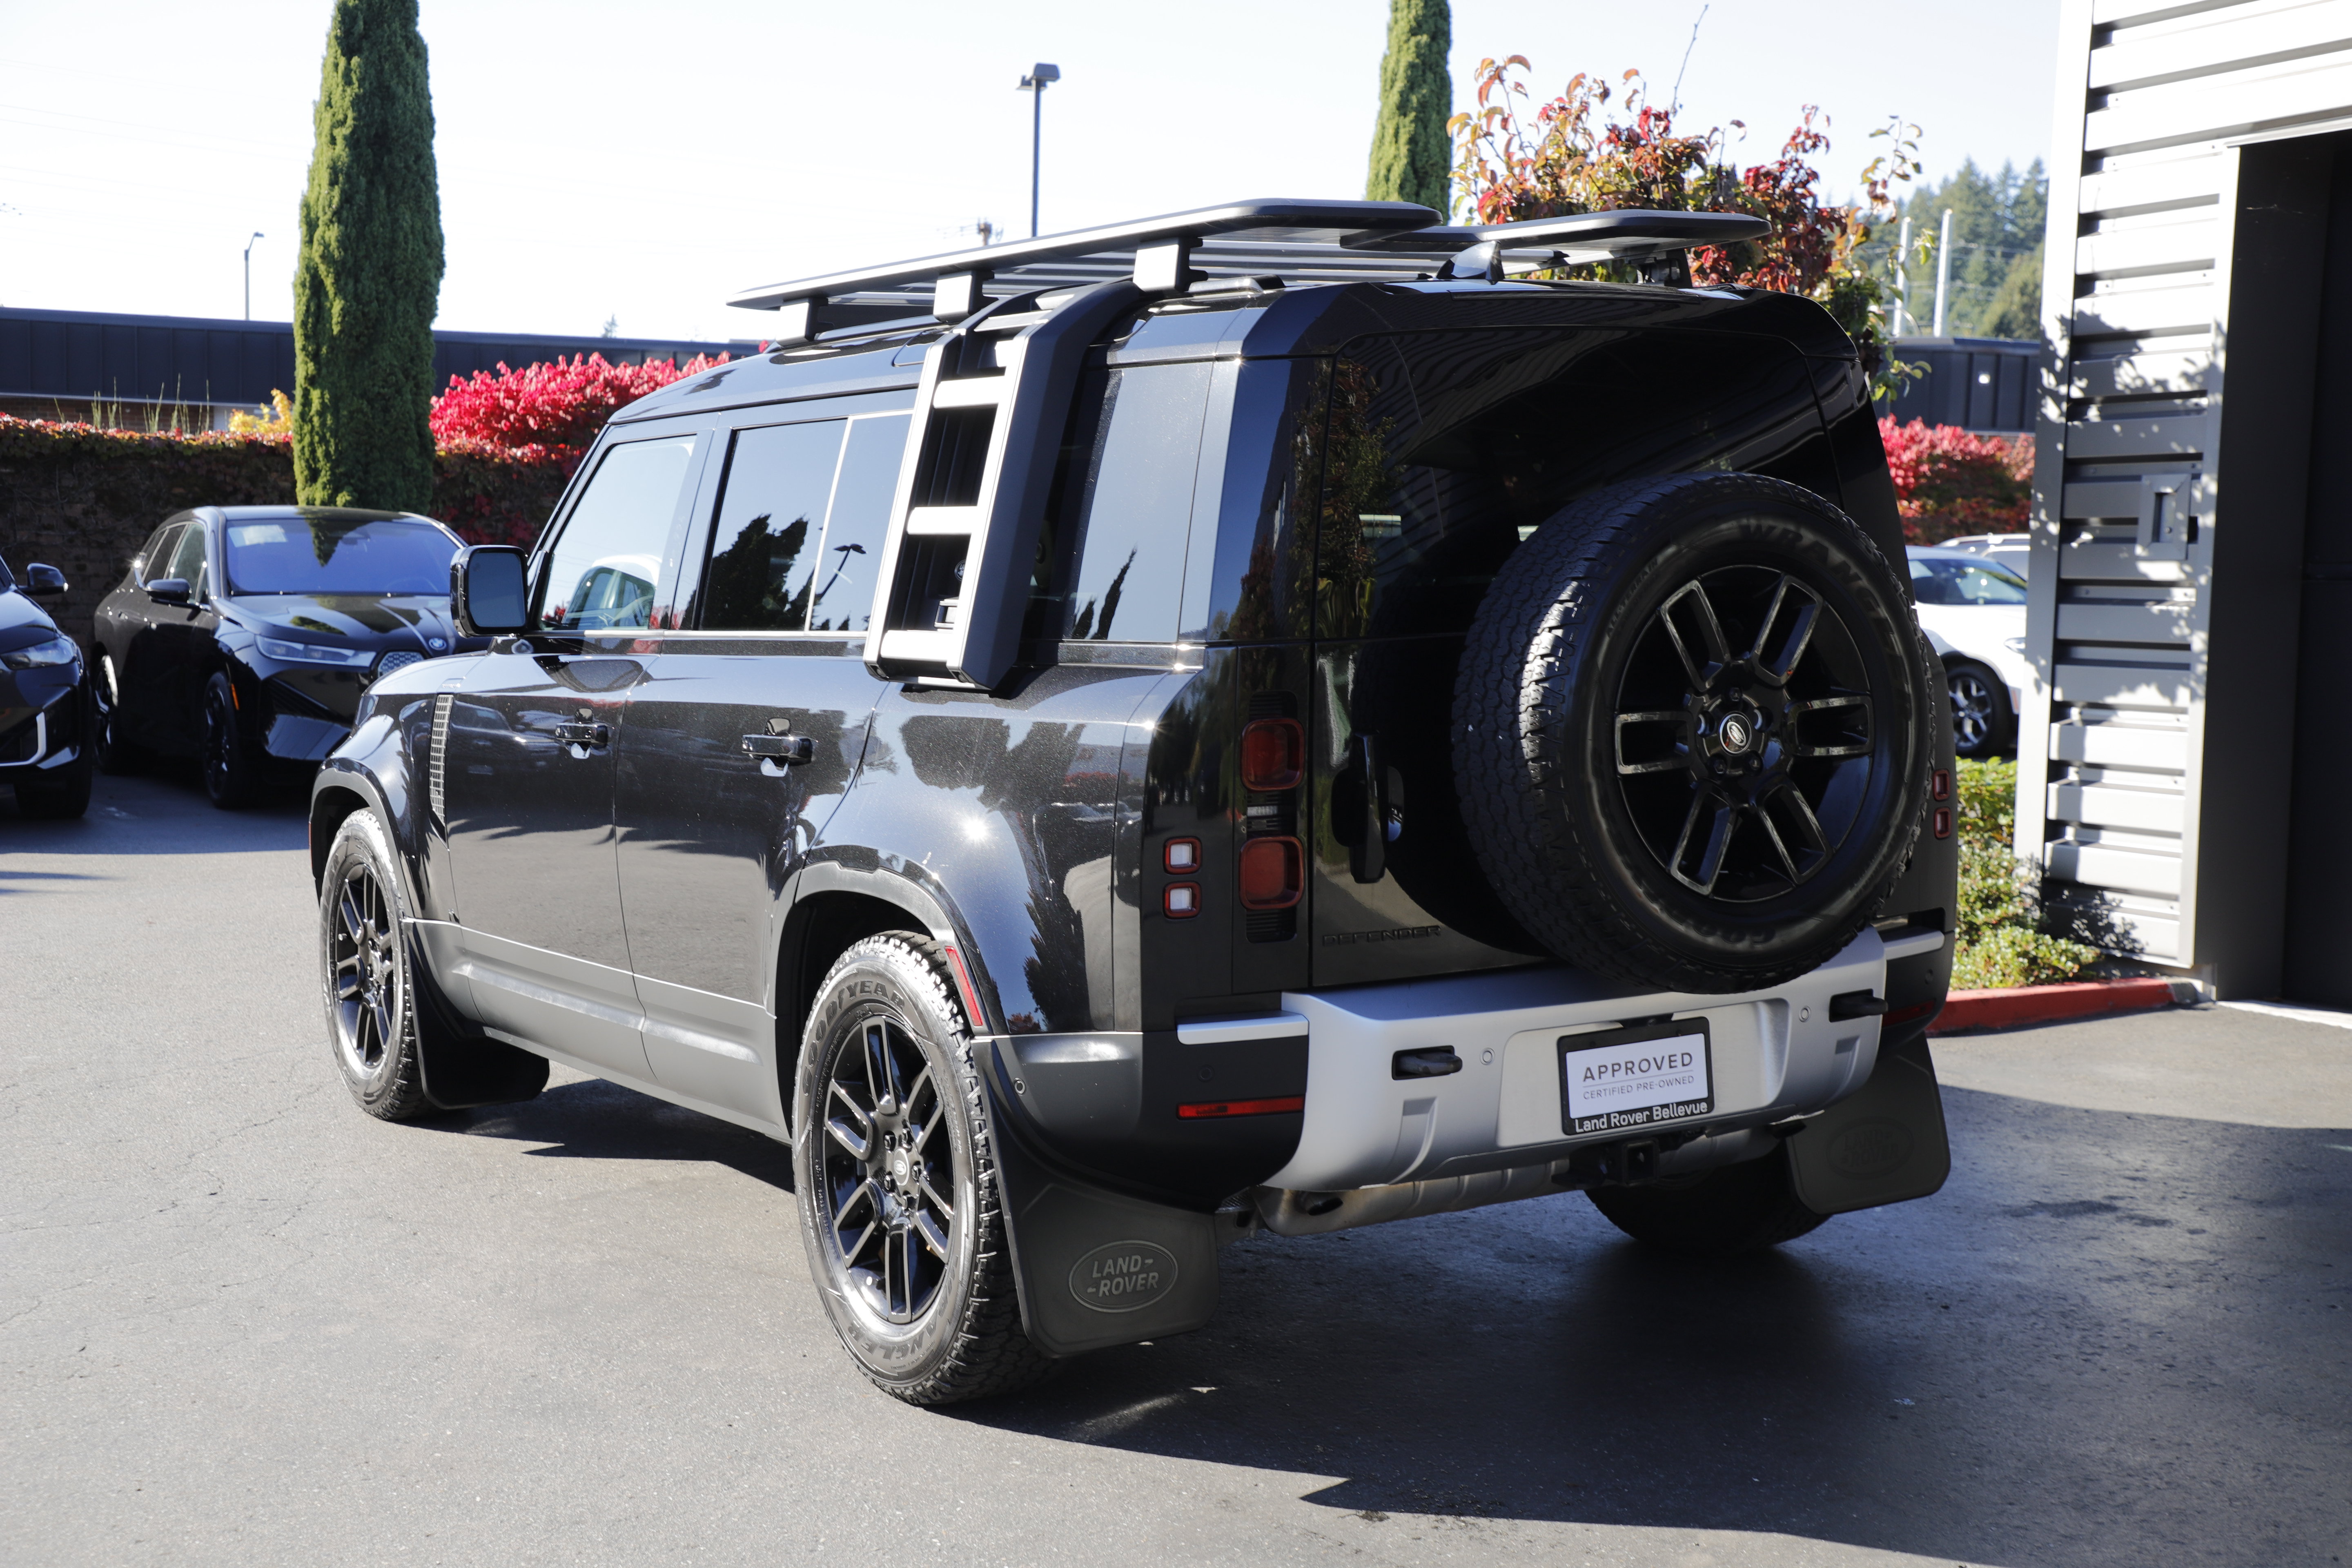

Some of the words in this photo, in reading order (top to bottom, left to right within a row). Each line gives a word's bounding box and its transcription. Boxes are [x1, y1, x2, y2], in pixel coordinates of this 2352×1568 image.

[1740, 524, 1912, 721] WRANGLER
[1323, 925, 1442, 947] DEFENDER
[803, 980, 905, 1096] GOODYEAR
[1583, 1052, 1693, 1082] APPROVED
[1584, 1085, 1633, 1100] CERTIFIED
[1637, 1076, 1694, 1091] PRE-OWNED
[1575, 1114, 1608, 1134] Land
[1611, 1110, 1650, 1127] Rover
[1653, 1102, 1708, 1121] Bellevue
[848, 1255, 959, 1361] WRANGLER
